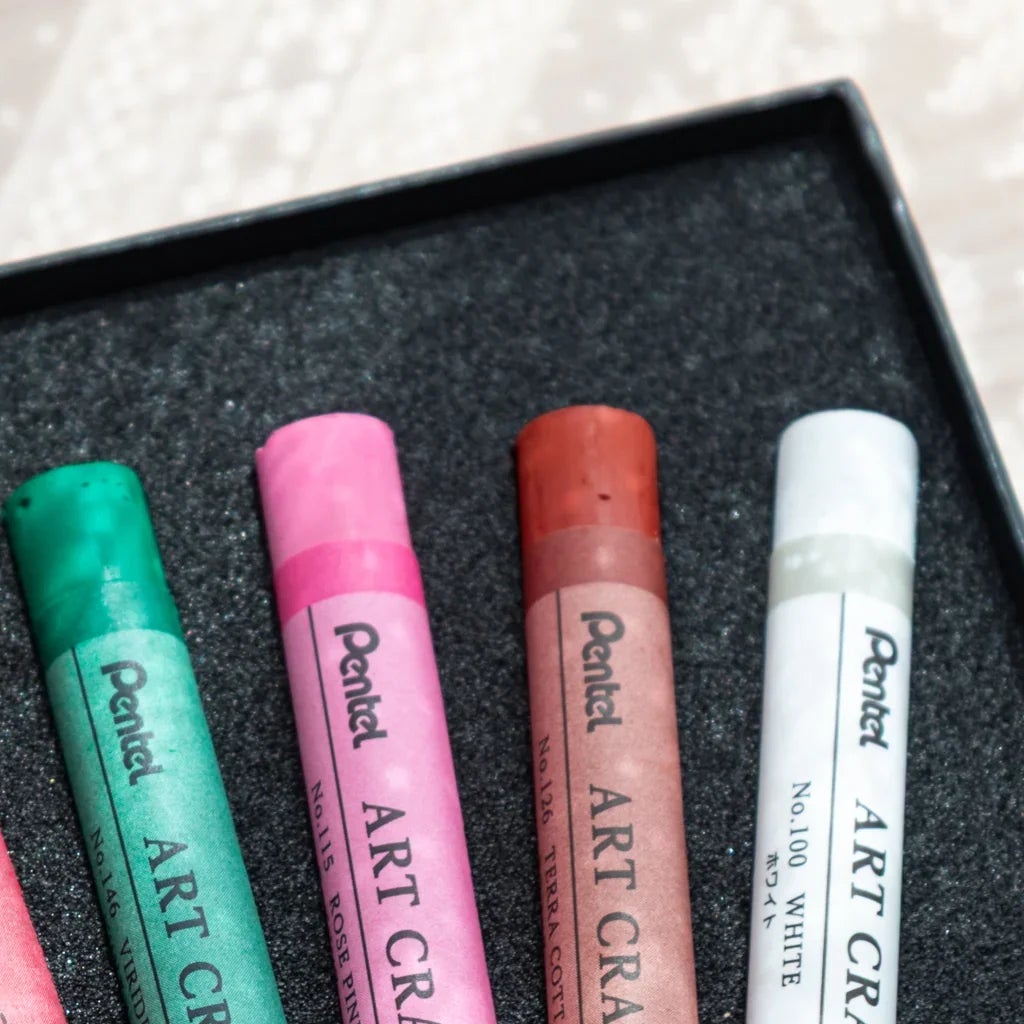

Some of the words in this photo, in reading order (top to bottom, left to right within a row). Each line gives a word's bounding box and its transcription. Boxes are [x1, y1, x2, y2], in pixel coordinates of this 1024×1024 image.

[101, 660, 162, 787] Pentel
[334, 622, 387, 748] Pentel
[580, 611, 624, 732] Pentel
[859, 626, 898, 749] Pentel
[538, 735, 554, 826] No.126
[788, 780, 811, 868] No.100
[90, 827, 120, 918] No.146
[144, 836, 210, 939] ART
[311, 780, 334, 873] No.115
[330, 892, 349, 968] ROSE
[362, 801, 421, 907] ART
[589, 784, 637, 891] ART
[763, 851, 779, 929] ホワイト
[850, 798, 888, 917] ART
[545, 845, 560, 938] TERRA
[781, 892, 806, 988] WHITE
